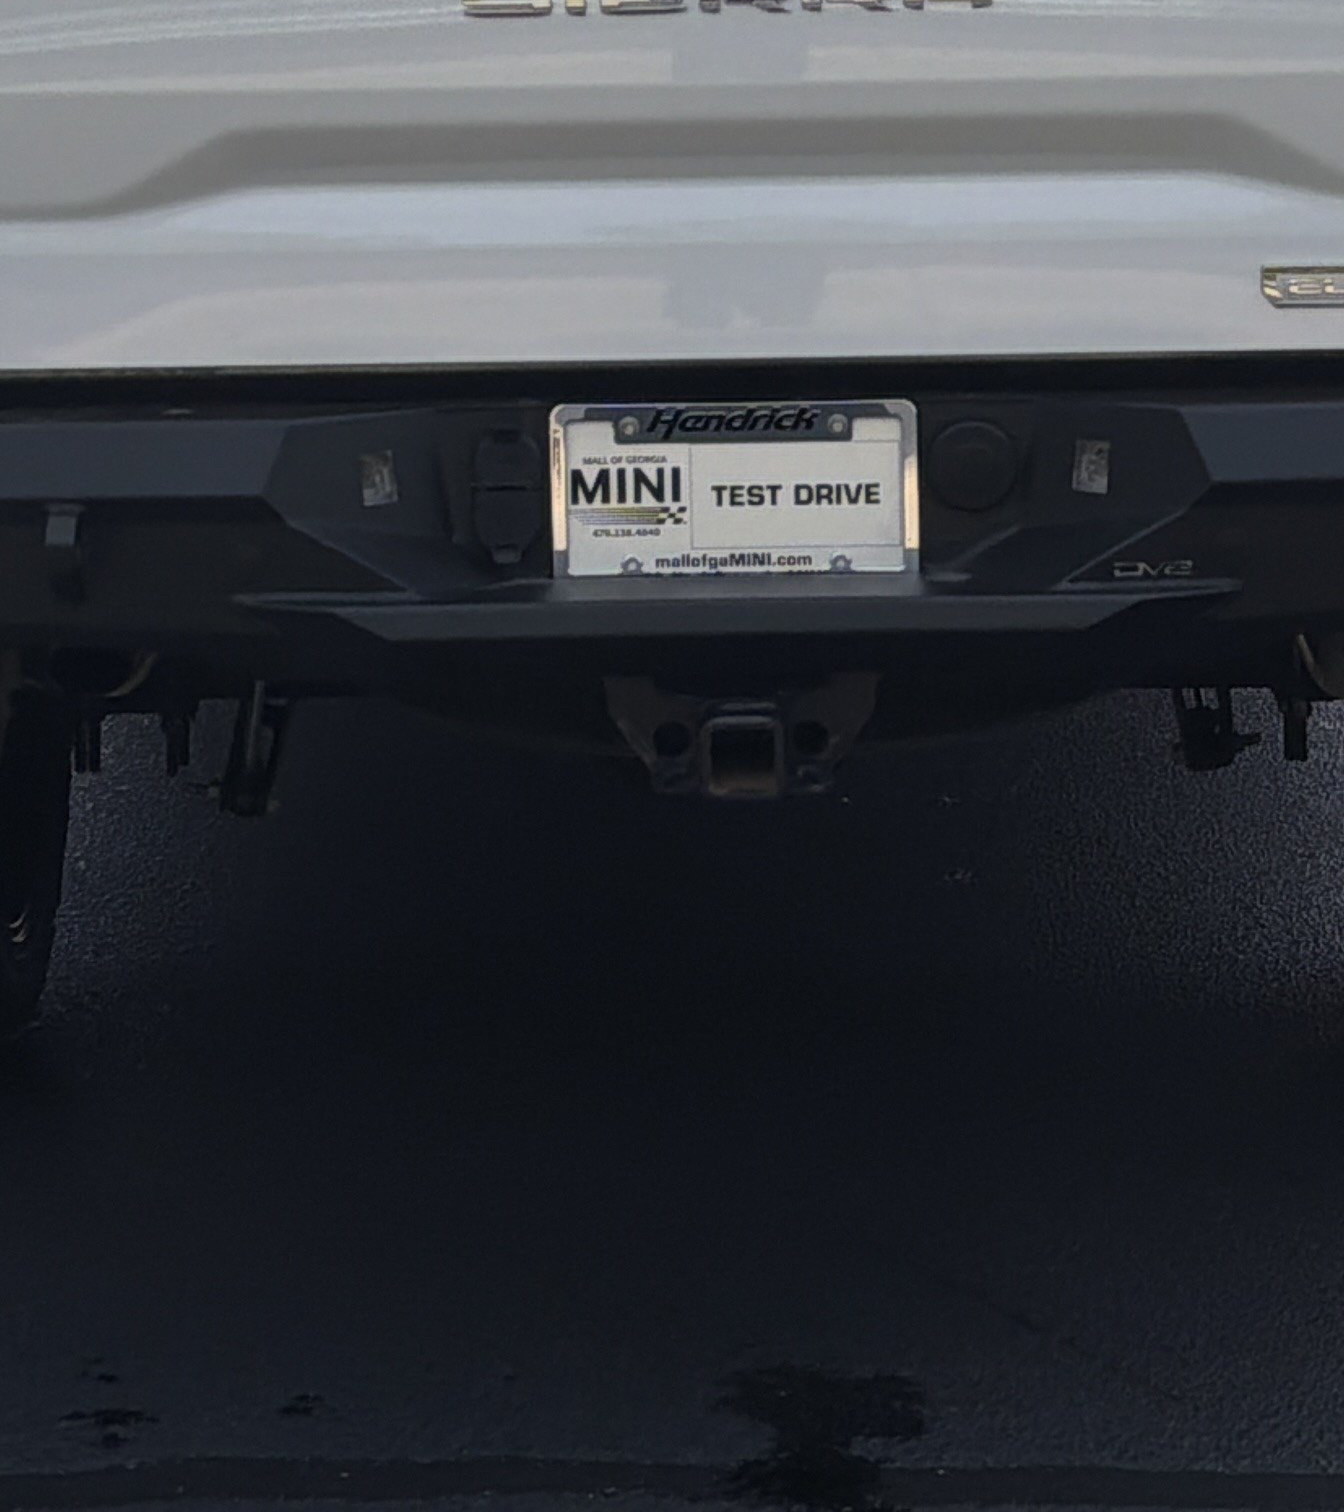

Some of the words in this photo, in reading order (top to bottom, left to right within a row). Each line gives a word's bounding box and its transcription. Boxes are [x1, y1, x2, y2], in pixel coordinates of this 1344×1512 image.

[646, 406, 820, 440] Hendrick
[582, 456, 608, 465] MALL
[610, 456, 623, 465] OF
[625, 455, 668, 464] GEORGIA
[570, 466, 681, 505] MINI
[711, 484, 782, 507] TEST
[793, 482, 881, 506] DRIVE
[656, 552, 813, 569] mallofgaMINI.com
